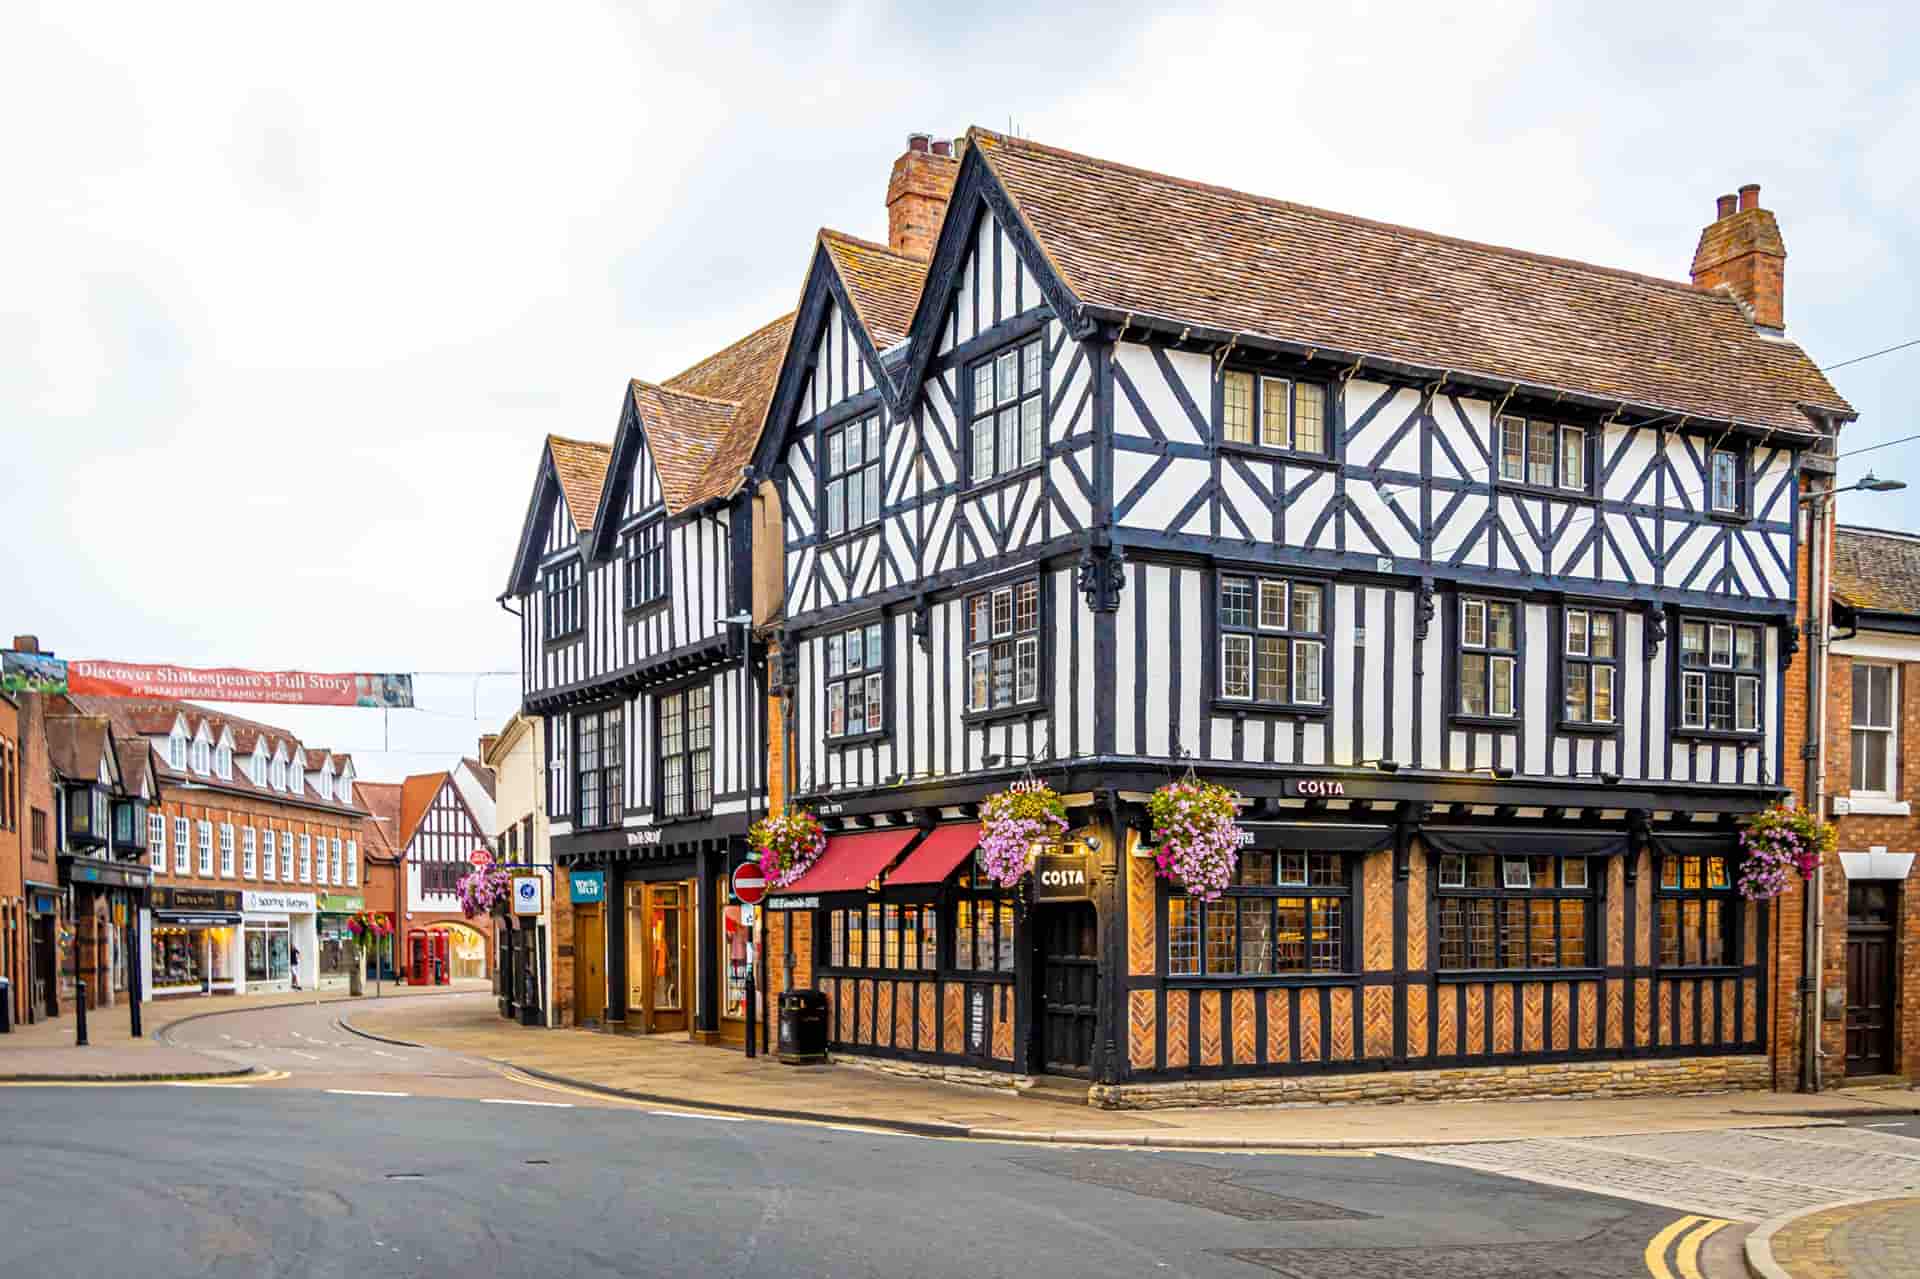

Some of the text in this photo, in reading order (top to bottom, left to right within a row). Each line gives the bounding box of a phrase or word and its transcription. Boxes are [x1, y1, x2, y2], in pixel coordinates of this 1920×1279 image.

[79, 663, 350, 694] Discover Shakespeare's Full Story
[1298, 780, 1344, 795] COSTA
[1041, 870, 1085, 886] COSTA
